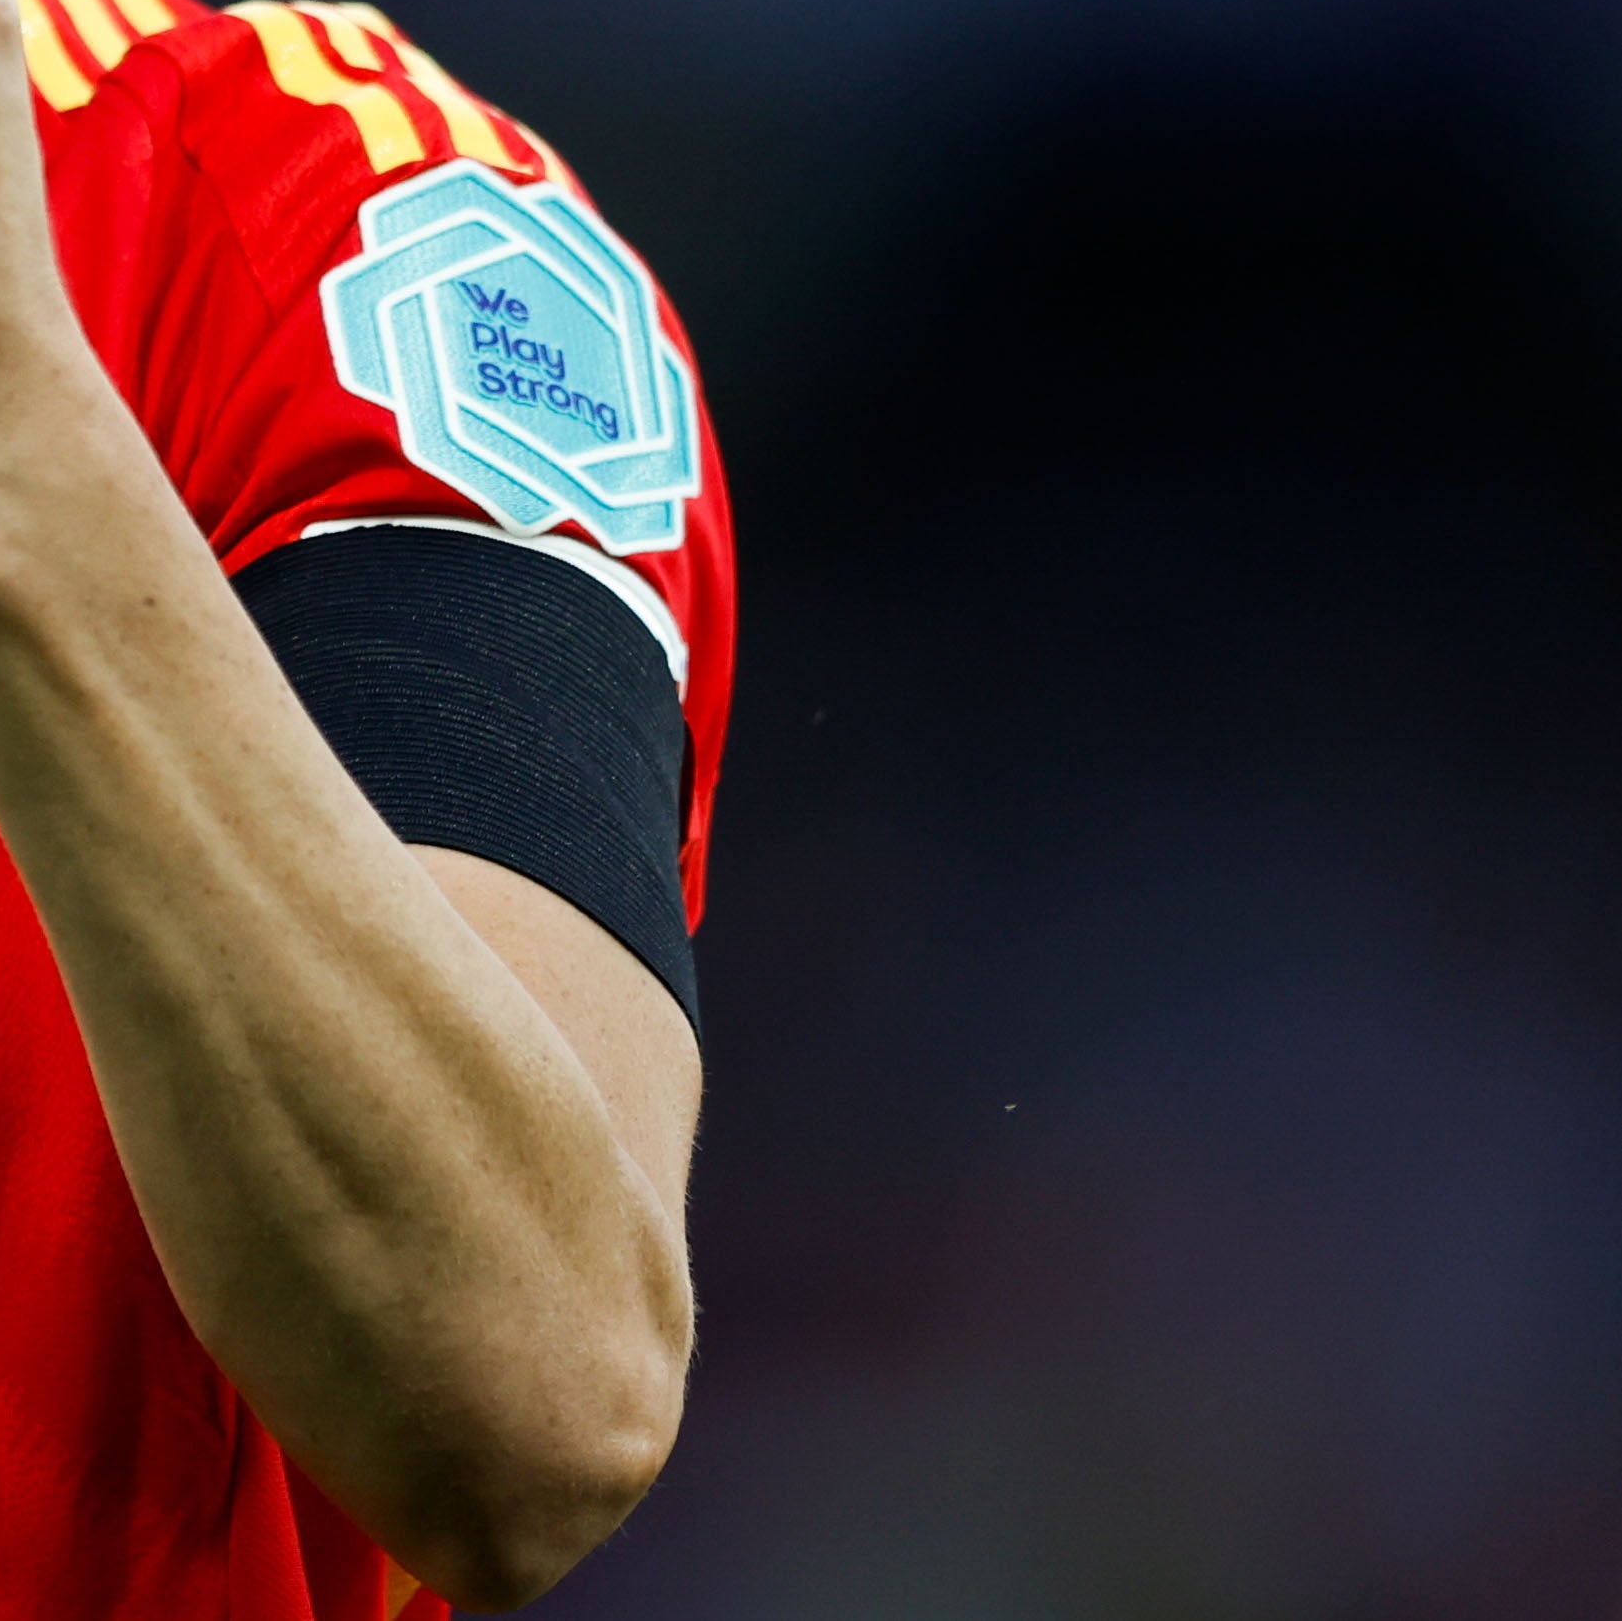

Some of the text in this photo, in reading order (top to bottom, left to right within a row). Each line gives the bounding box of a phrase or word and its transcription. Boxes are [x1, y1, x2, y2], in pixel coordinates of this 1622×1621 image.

[459, 281, 530, 323] We
[470, 321, 566, 380] Play
[477, 362, 619, 440] Strong
